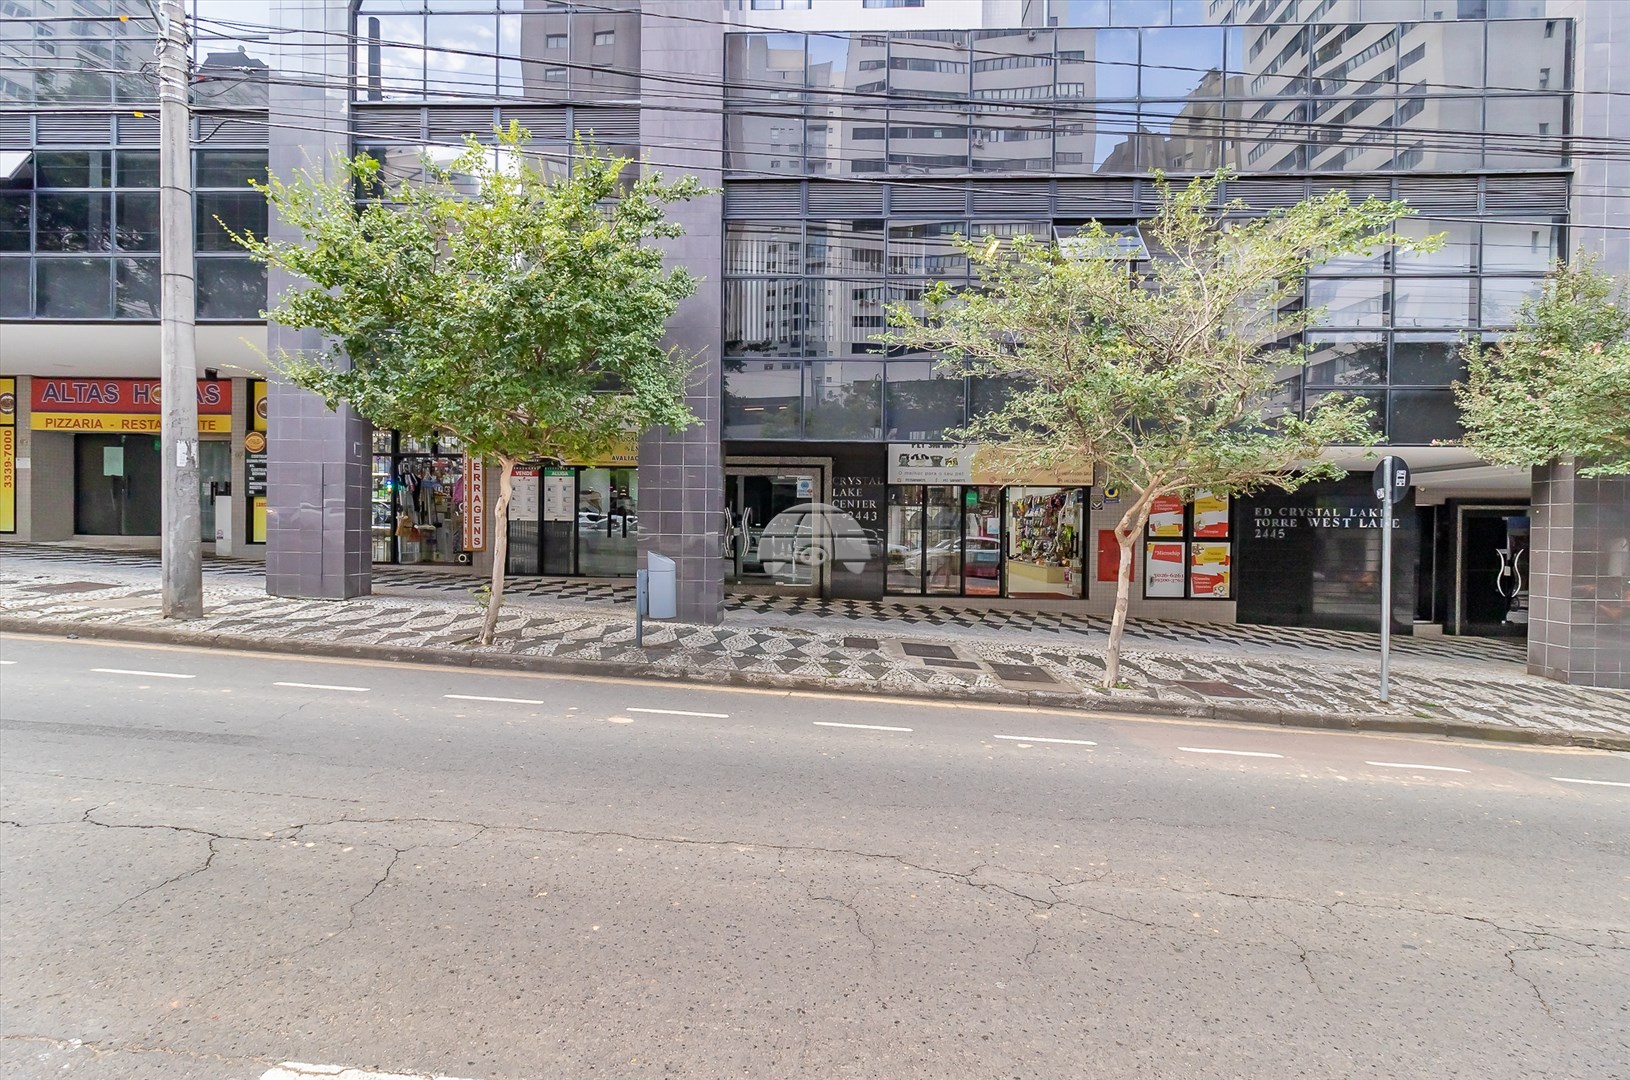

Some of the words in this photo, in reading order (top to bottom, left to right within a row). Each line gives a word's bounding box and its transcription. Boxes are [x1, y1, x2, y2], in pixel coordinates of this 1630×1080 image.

[41, 382, 120, 404] ALTAS
[45, 418, 103, 429] PIZZARIA
[4, 429, 12, 488] 3339-7000
[832, 476, 884, 486] CRYSTAL
[832, 488, 863, 497] LAKE
[473, 462, 482, 545] ERRAGENS
[1254, 507, 1272, 517] ED
[1279, 507, 1341, 517] CRYSTAL
[1254, 518, 1298, 528] TORRE
[1307, 517, 1352, 528] WEST
[1254, 528, 1286, 538] 2445
